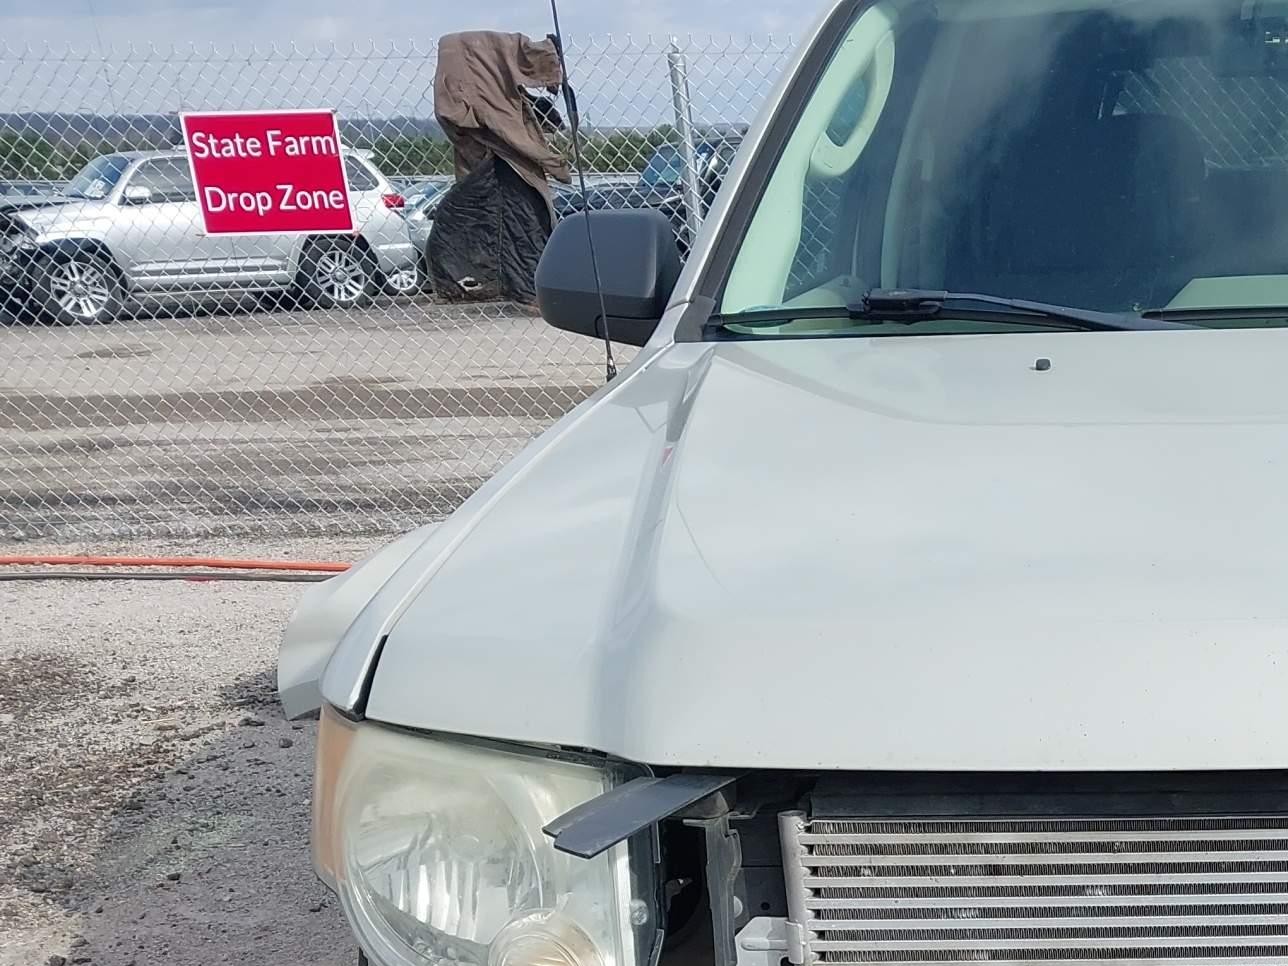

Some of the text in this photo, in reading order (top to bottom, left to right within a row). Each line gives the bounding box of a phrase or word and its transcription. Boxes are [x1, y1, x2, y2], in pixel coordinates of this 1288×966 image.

[192, 130, 337, 159] State Farm
[204, 184, 345, 217] Drop Zone
